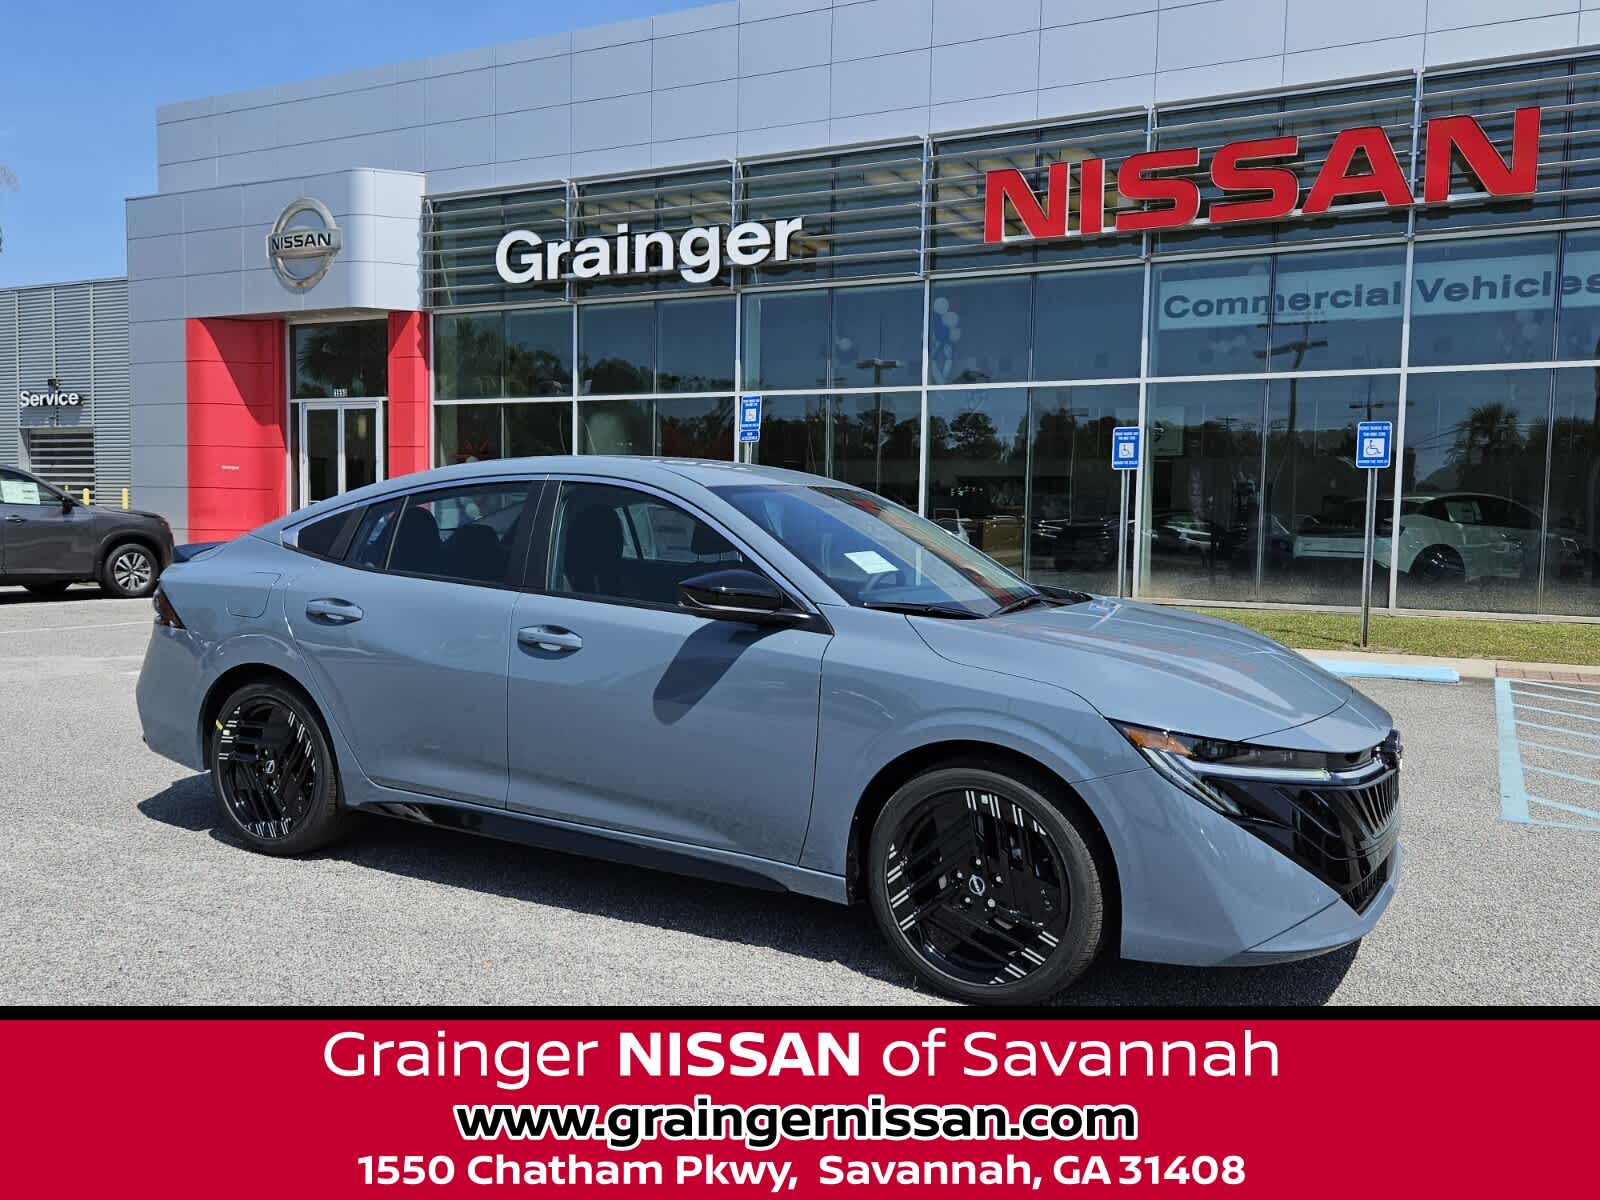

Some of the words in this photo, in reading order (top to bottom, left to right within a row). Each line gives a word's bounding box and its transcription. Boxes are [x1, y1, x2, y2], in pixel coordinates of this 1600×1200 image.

[984, 106, 1541, 244] NISSAN
[271, 233, 332, 250] NISSAN
[495, 217, 804, 284] Grainger
[1164, 281, 1402, 318] Commercial
[20, 391, 80, 407] Service
